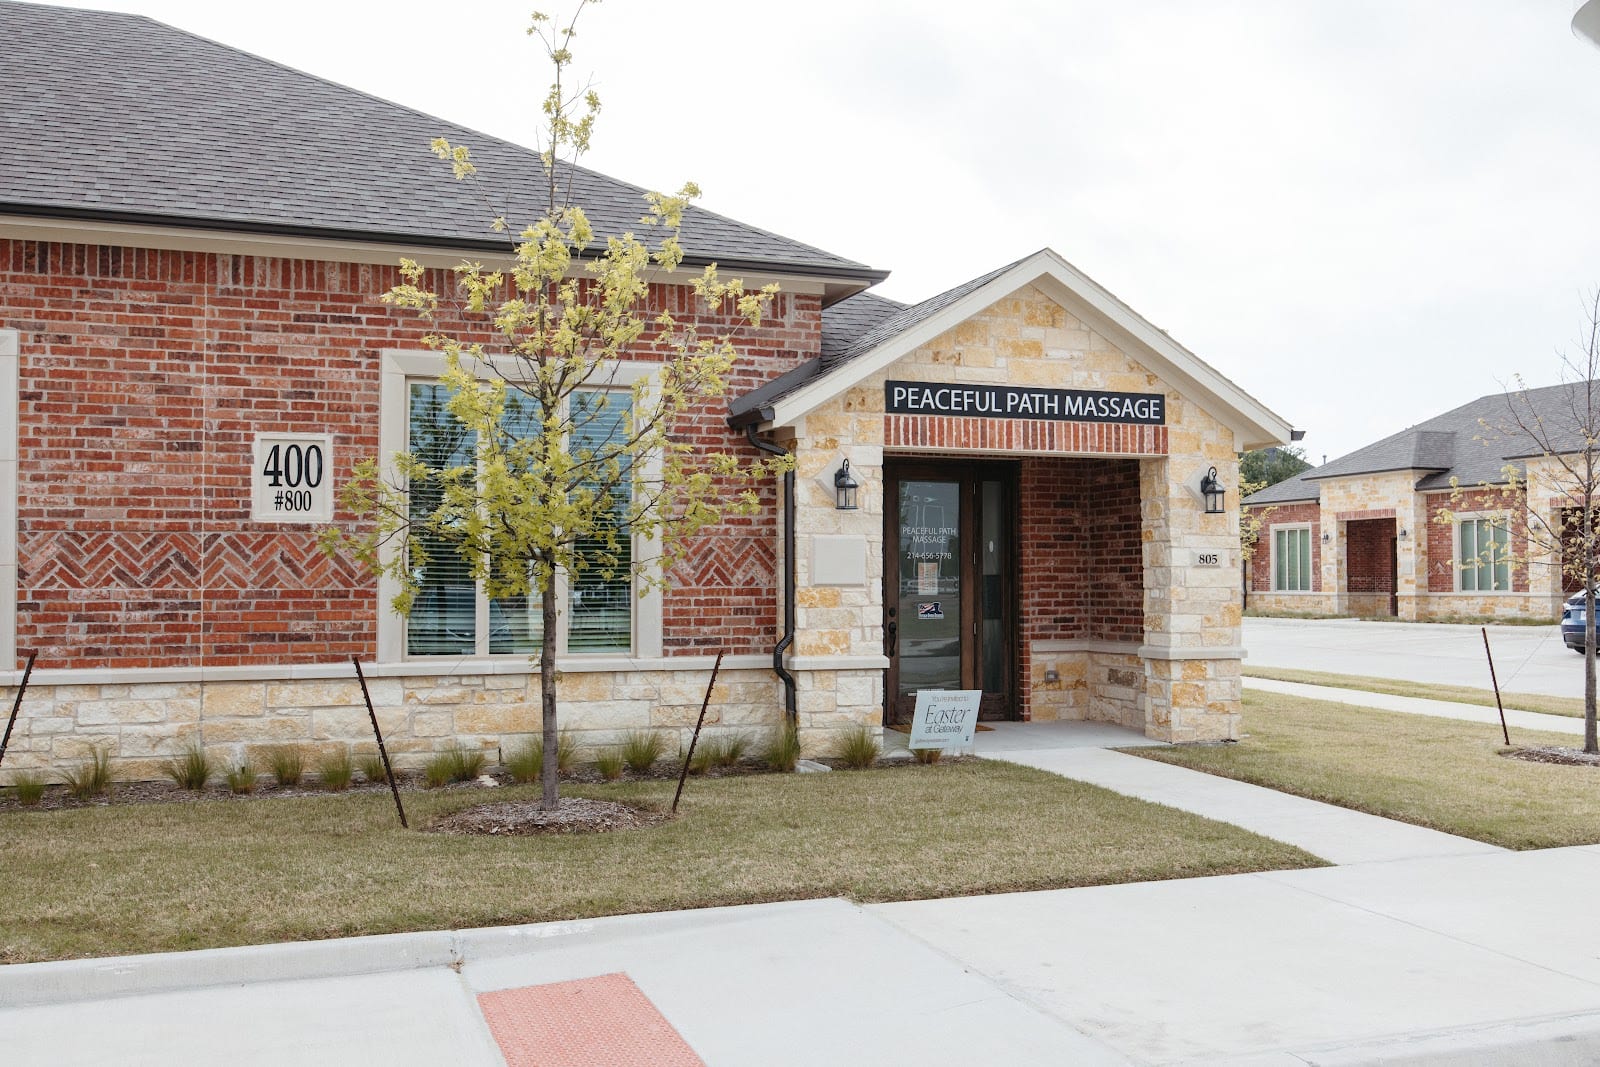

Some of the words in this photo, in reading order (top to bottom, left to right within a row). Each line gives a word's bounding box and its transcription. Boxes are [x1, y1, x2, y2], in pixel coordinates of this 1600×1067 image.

[893, 387, 1002, 413] PEACEFUL
[1006, 392, 1059, 415] PATH
[1064, 395, 1161, 419] MASSAGE
[263, 444, 323, 488] 400
[274, 490, 312, 511] #800
[902, 526, 937, 535] PEACEFUL
[939, 527, 957, 536] PATH
[912, 535, 947, 544] MASSAGE
[1198, 554, 1218, 565] 805
[925, 704, 971, 724] Easter
[925, 725, 933, 734] at
[933, 724, 964, 734] Gateway
